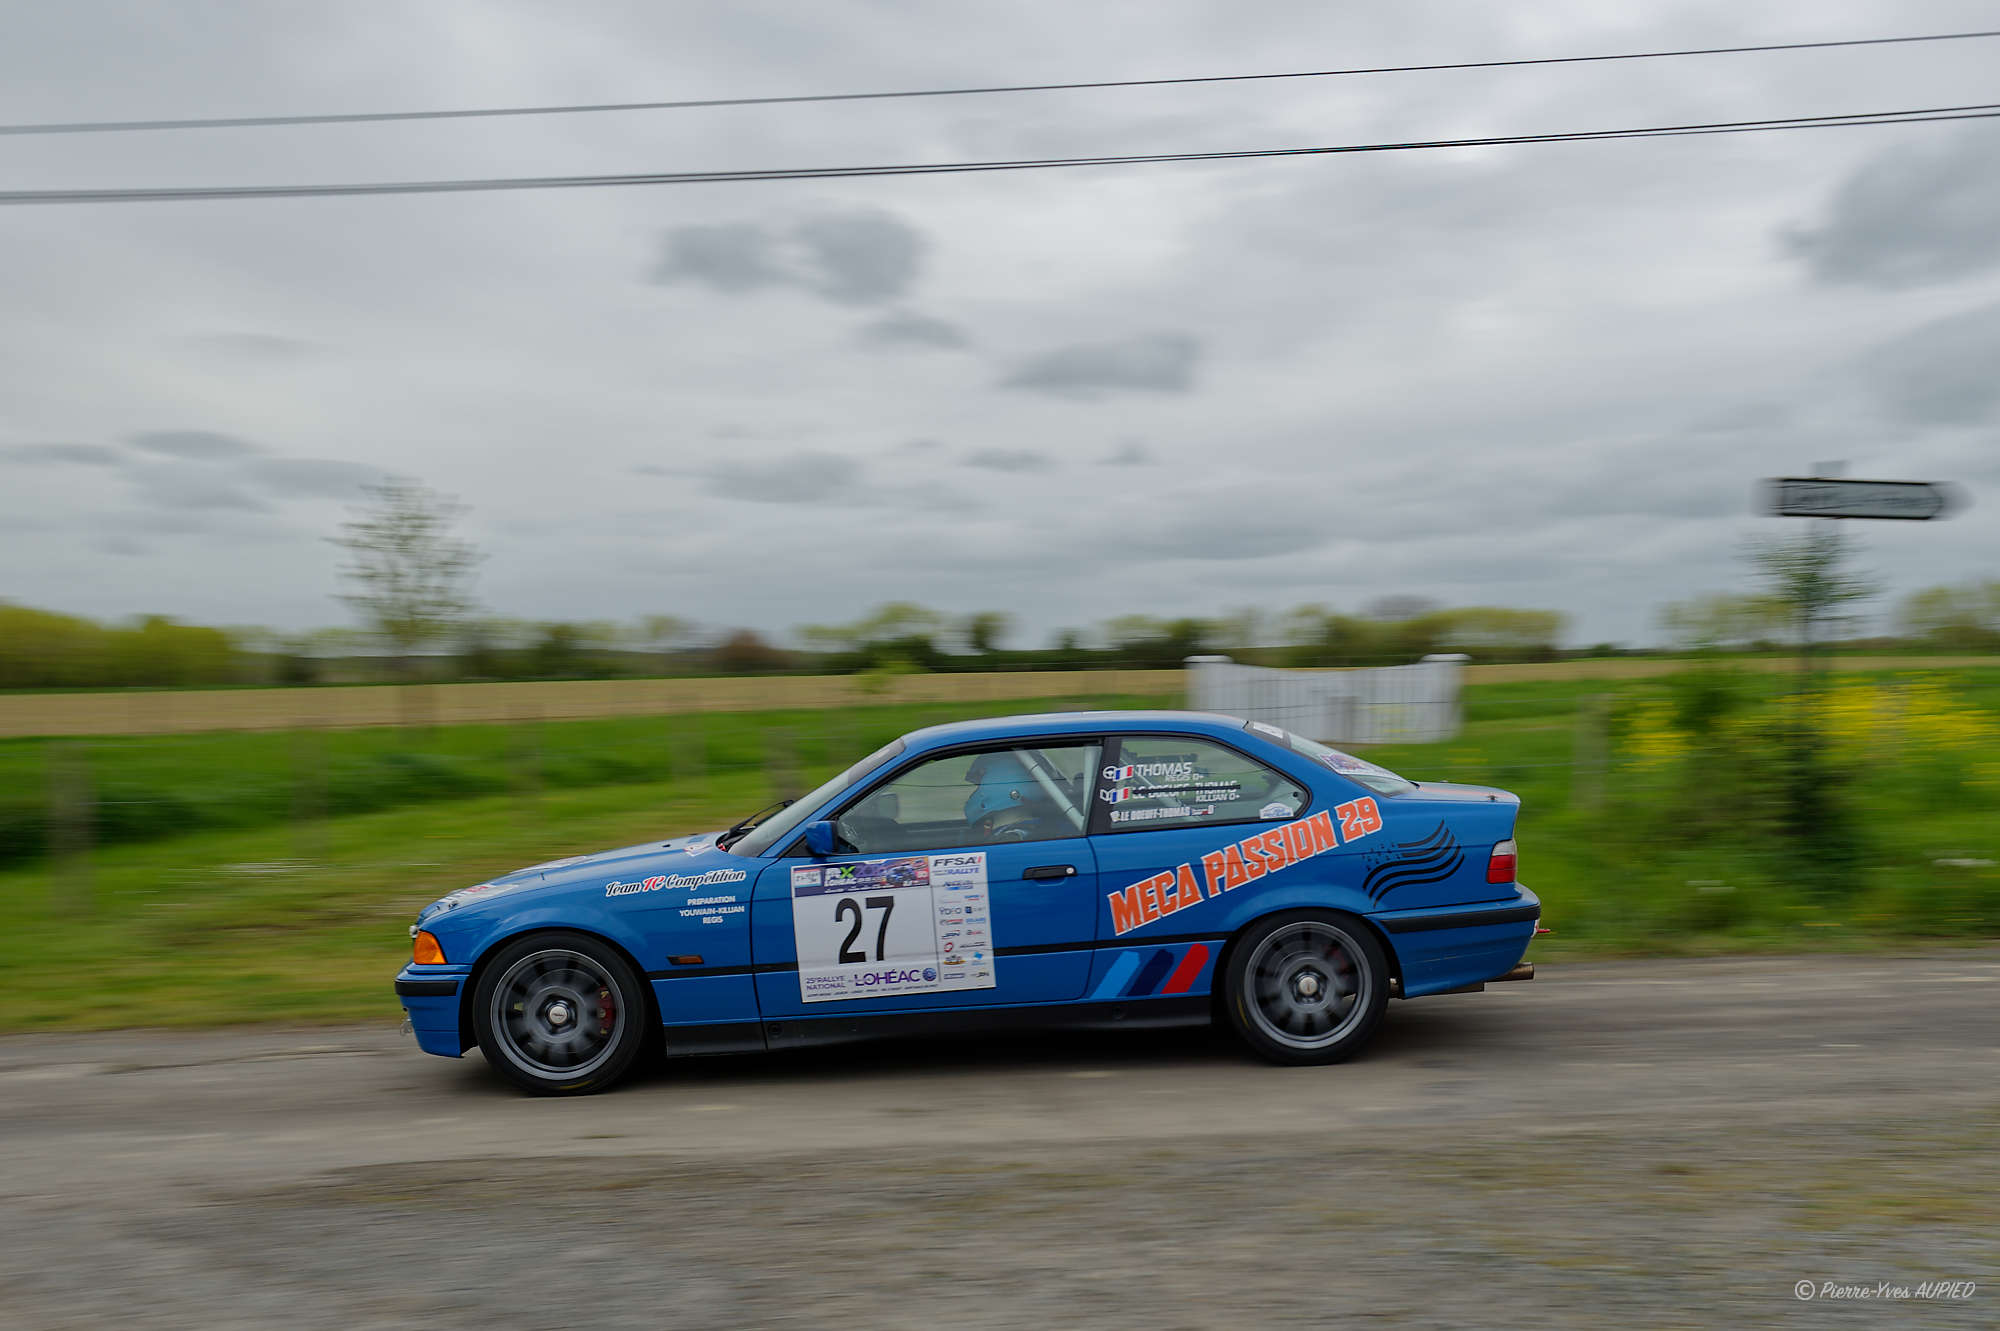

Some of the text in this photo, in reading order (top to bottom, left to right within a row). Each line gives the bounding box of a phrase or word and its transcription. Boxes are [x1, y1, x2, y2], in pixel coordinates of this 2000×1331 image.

[1136, 762, 1192, 777] THOMAS
[934, 857, 977, 866] FFSA
[1107, 796, 1383, 936] MECA PASSION 29
[606, 881, 641, 897] Team
[835, 896, 894, 964] 27
[806, 982, 846, 990] NATIONAL
[854, 969, 921, 987] LOHÉAC
